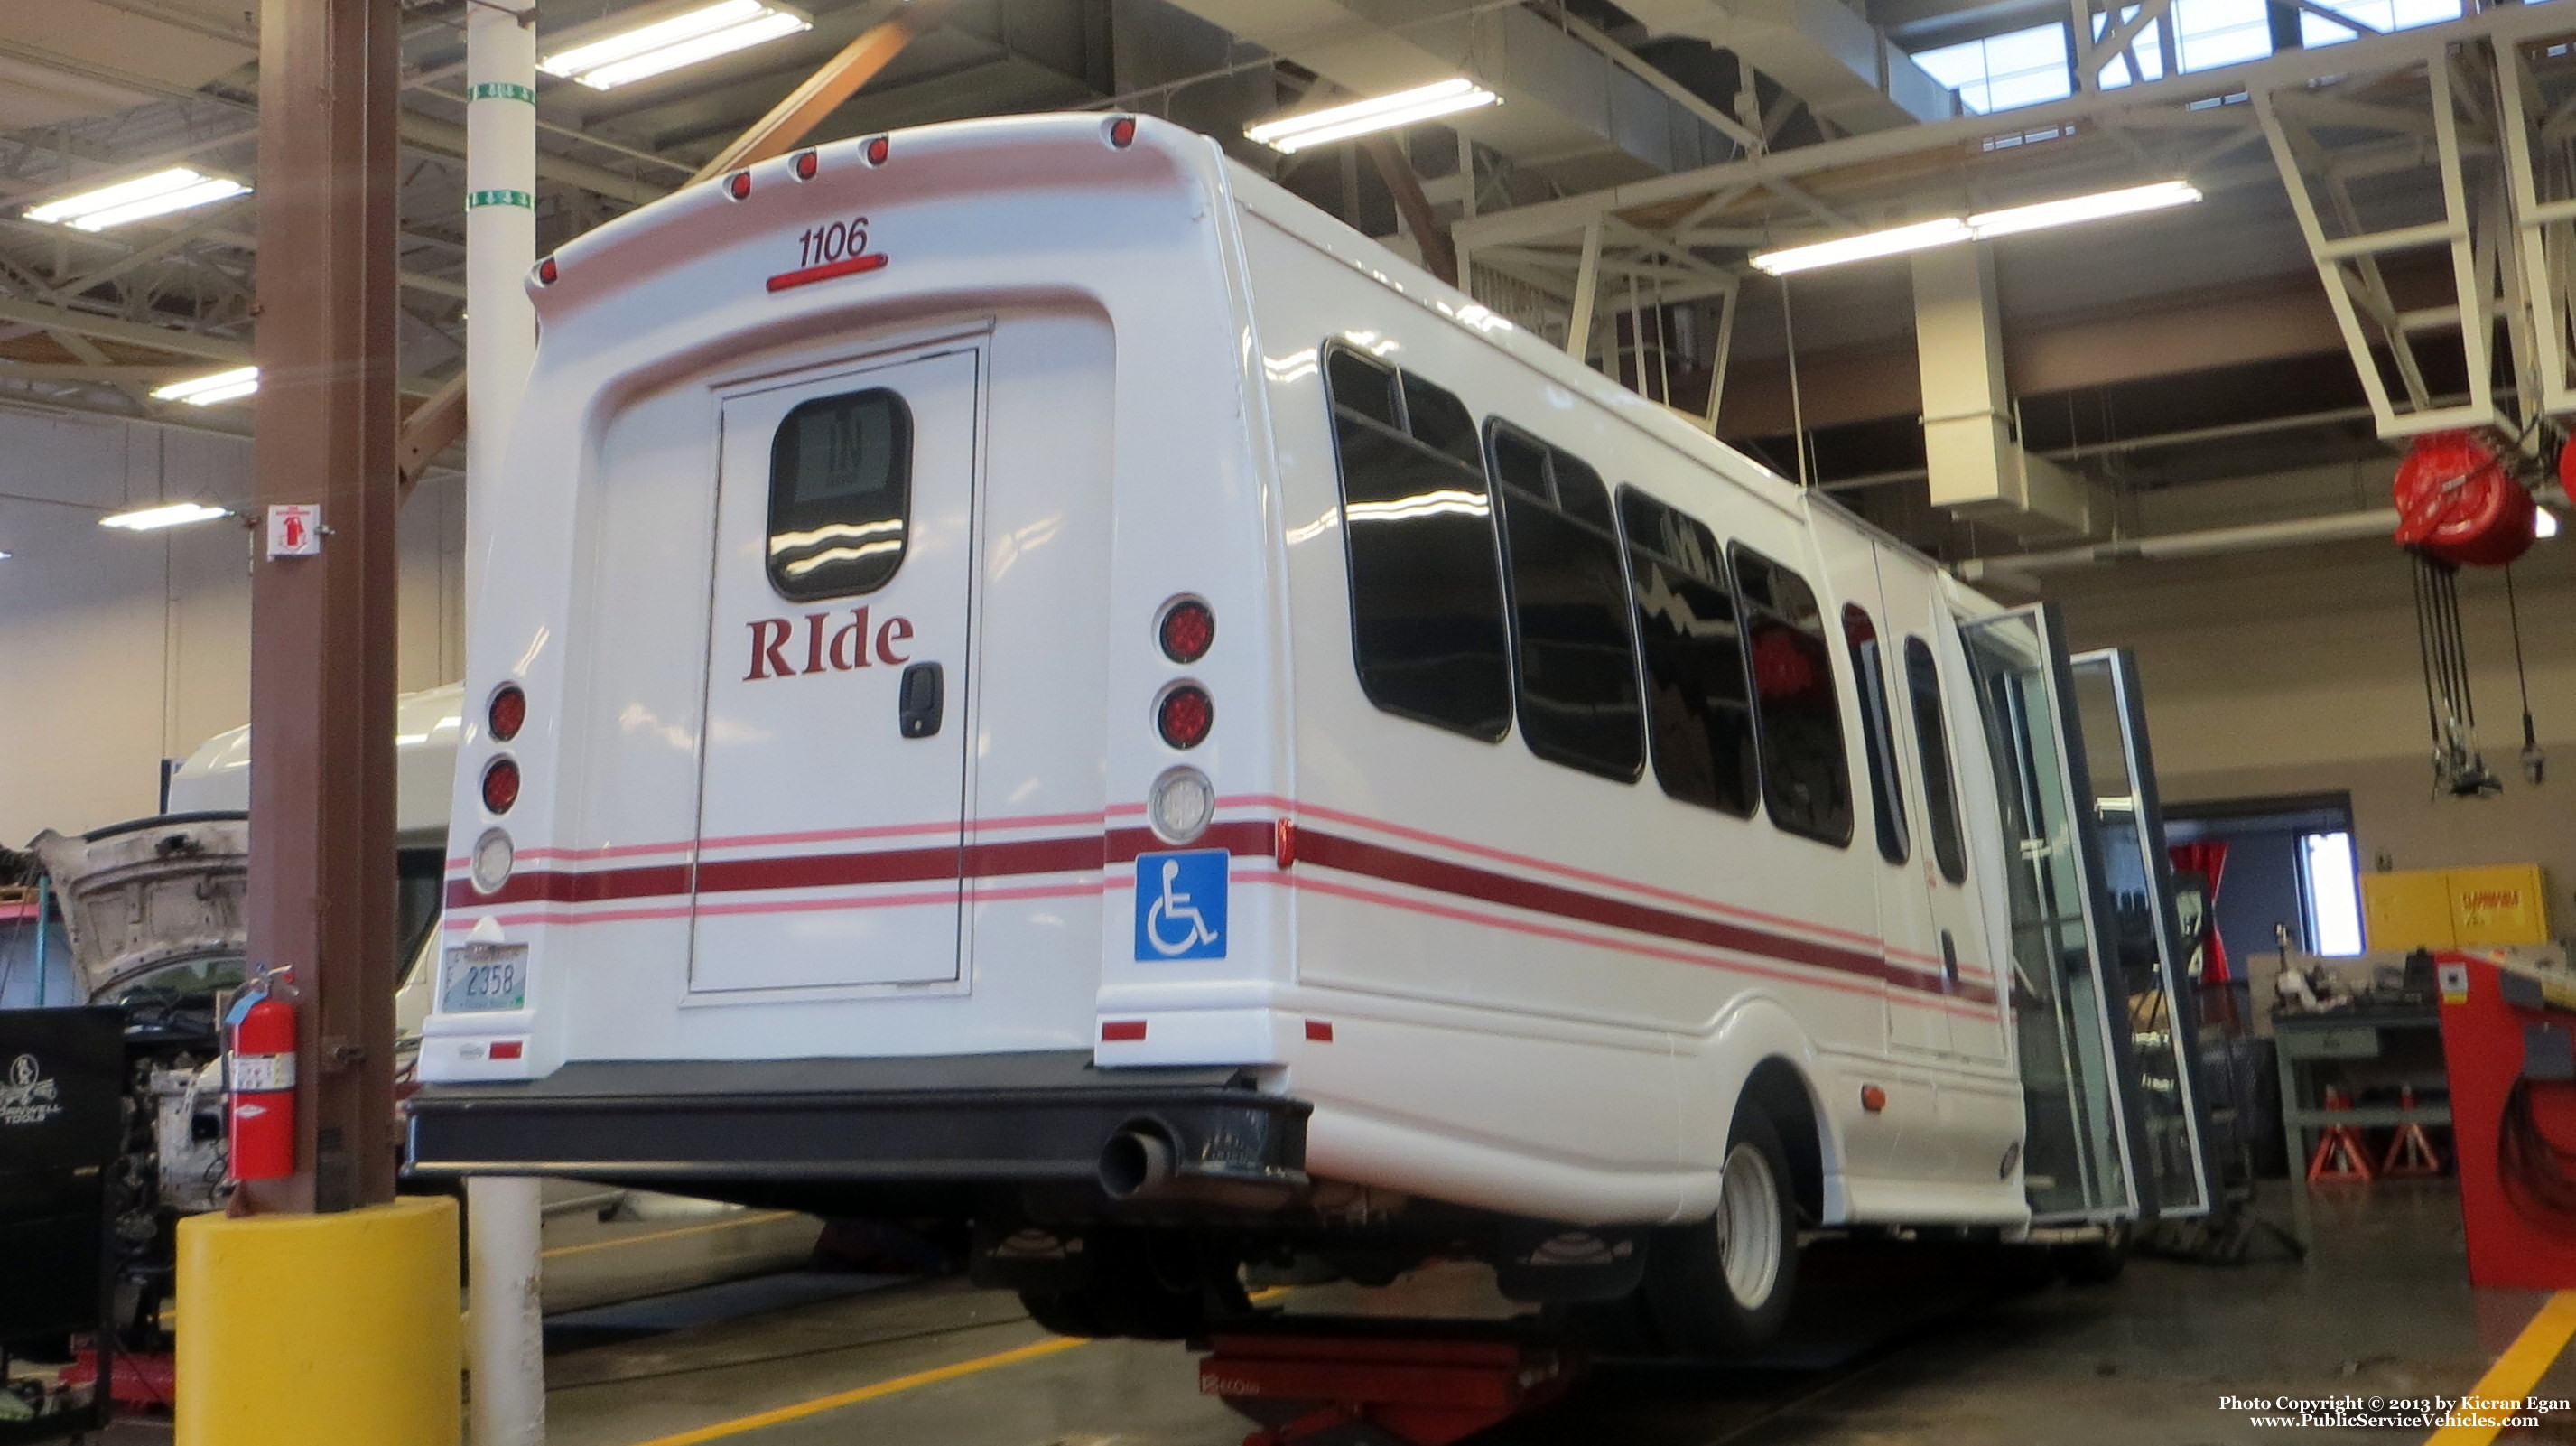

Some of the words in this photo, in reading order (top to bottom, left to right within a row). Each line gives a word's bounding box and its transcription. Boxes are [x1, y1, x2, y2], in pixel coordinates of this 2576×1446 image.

[799, 216, 869, 268] 1106
[742, 604, 914, 682] RIde
[468, 964, 515, 996] 2358
[0, 1104, 63, 1117] ORNWELL
